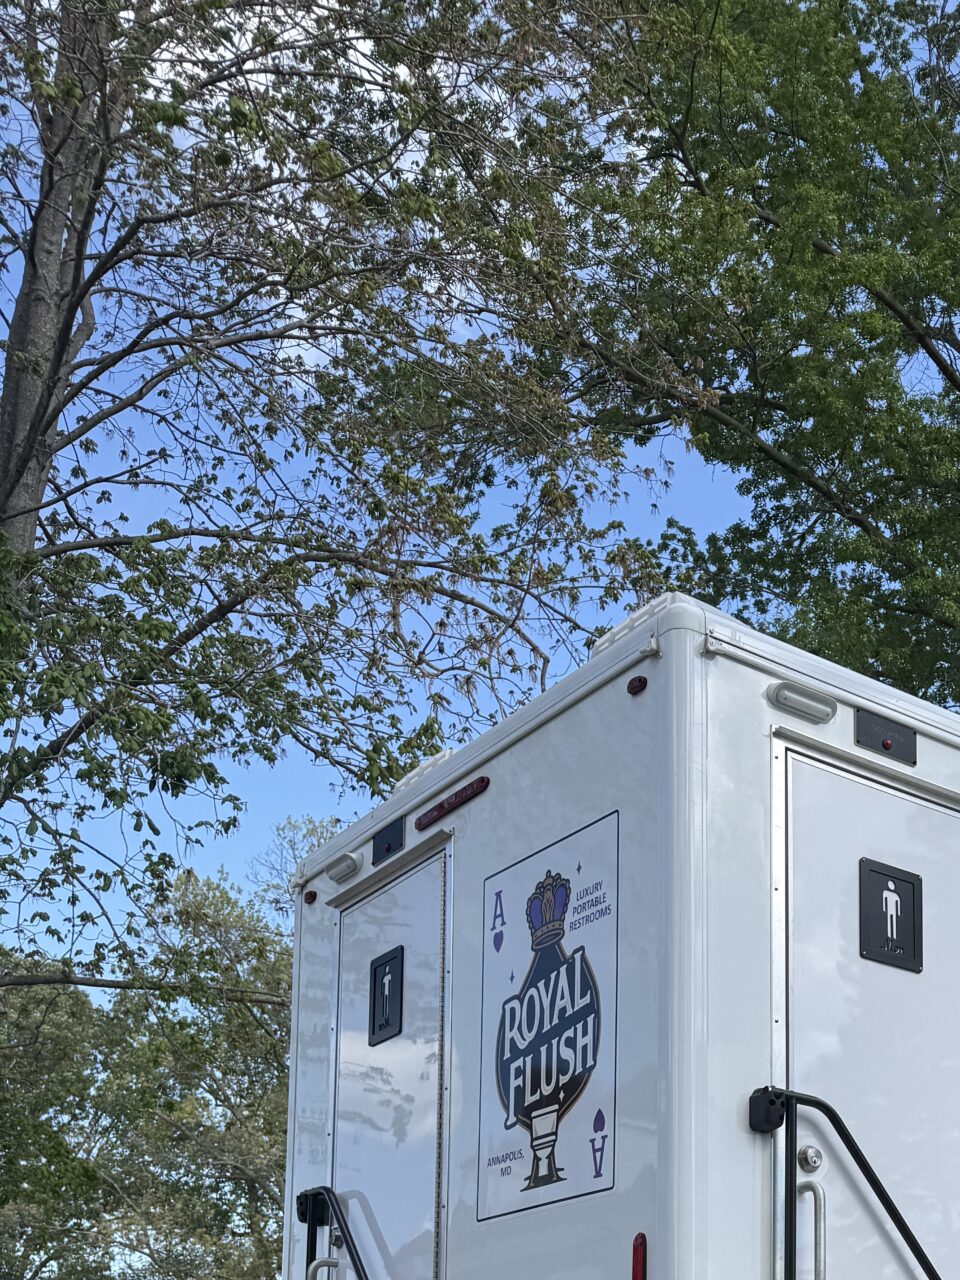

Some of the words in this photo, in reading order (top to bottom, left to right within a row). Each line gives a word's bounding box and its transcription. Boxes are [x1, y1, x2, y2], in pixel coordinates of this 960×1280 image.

[576, 880, 603, 901] LUXURY
[490, 890, 506, 932] A
[572, 892, 607, 917] PORTABLE
[569, 904, 612, 932] RESTROOMS
[503, 949, 591, 1060] ROYAL
[505, 1013, 595, 1126] FLUSH
[487, 1149, 525, 1168] ANNAPOLIS,
[500, 1165, 512, 1177] MD
